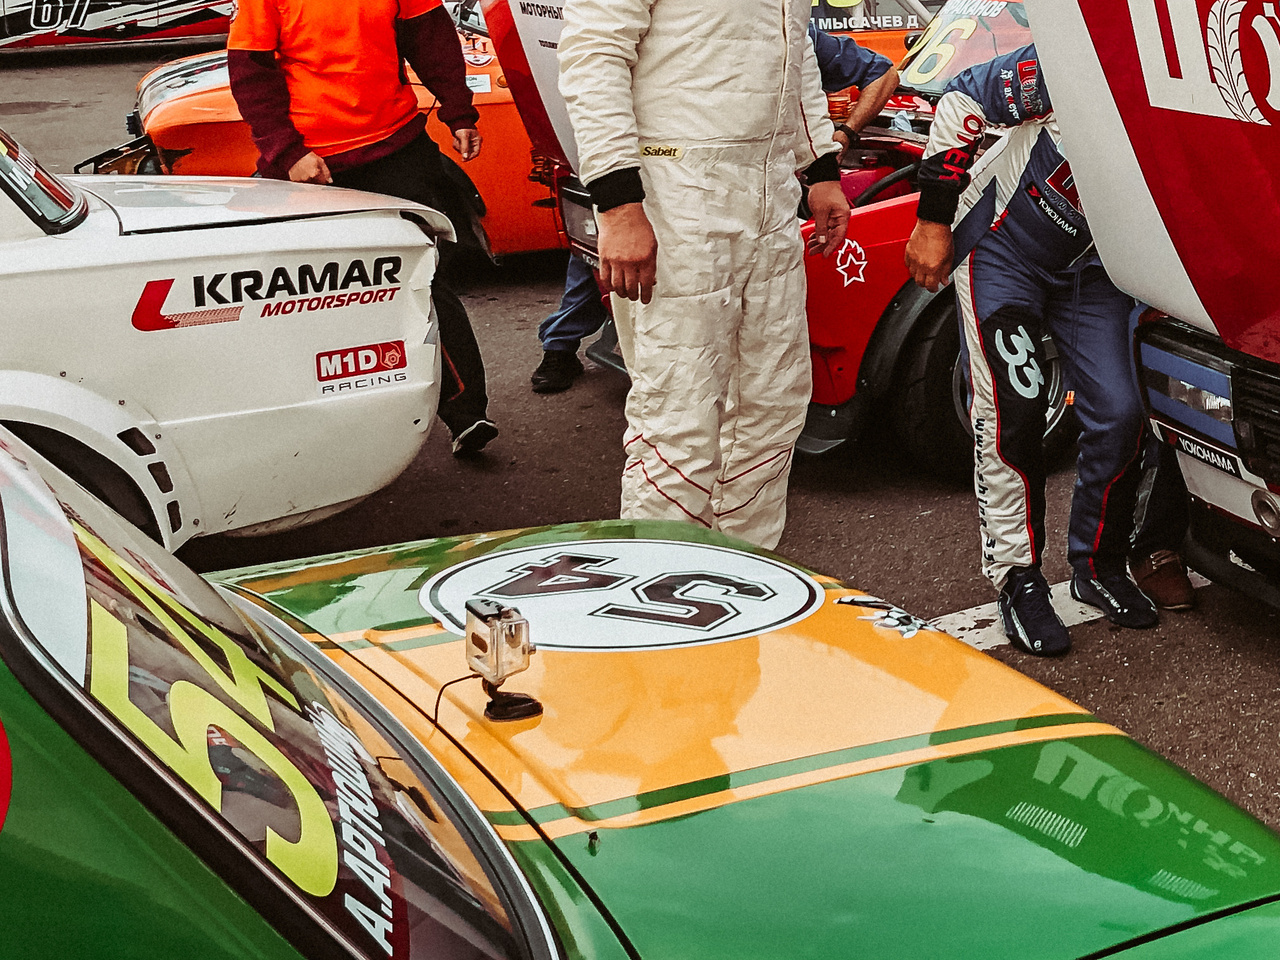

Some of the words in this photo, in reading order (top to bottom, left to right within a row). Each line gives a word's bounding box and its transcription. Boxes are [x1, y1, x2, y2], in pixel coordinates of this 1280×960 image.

[818, 16, 903, 29] МЫСАЧЕВ
[906, 14, 919, 28] Д
[642, 146, 678, 158] Sabelt
[1038, 197, 1078, 237] YOKOHAMA
[193, 256, 402, 307] KRAMAR
[260, 286, 402, 318] MOTORSPORT
[318, 348, 378, 378] M1D
[995, 325, 1045, 400] 33
[322, 372, 408, 394] RACING
[1179, 436, 1236, 474] YOKOHAMA
[474, 551, 780, 631] 54
